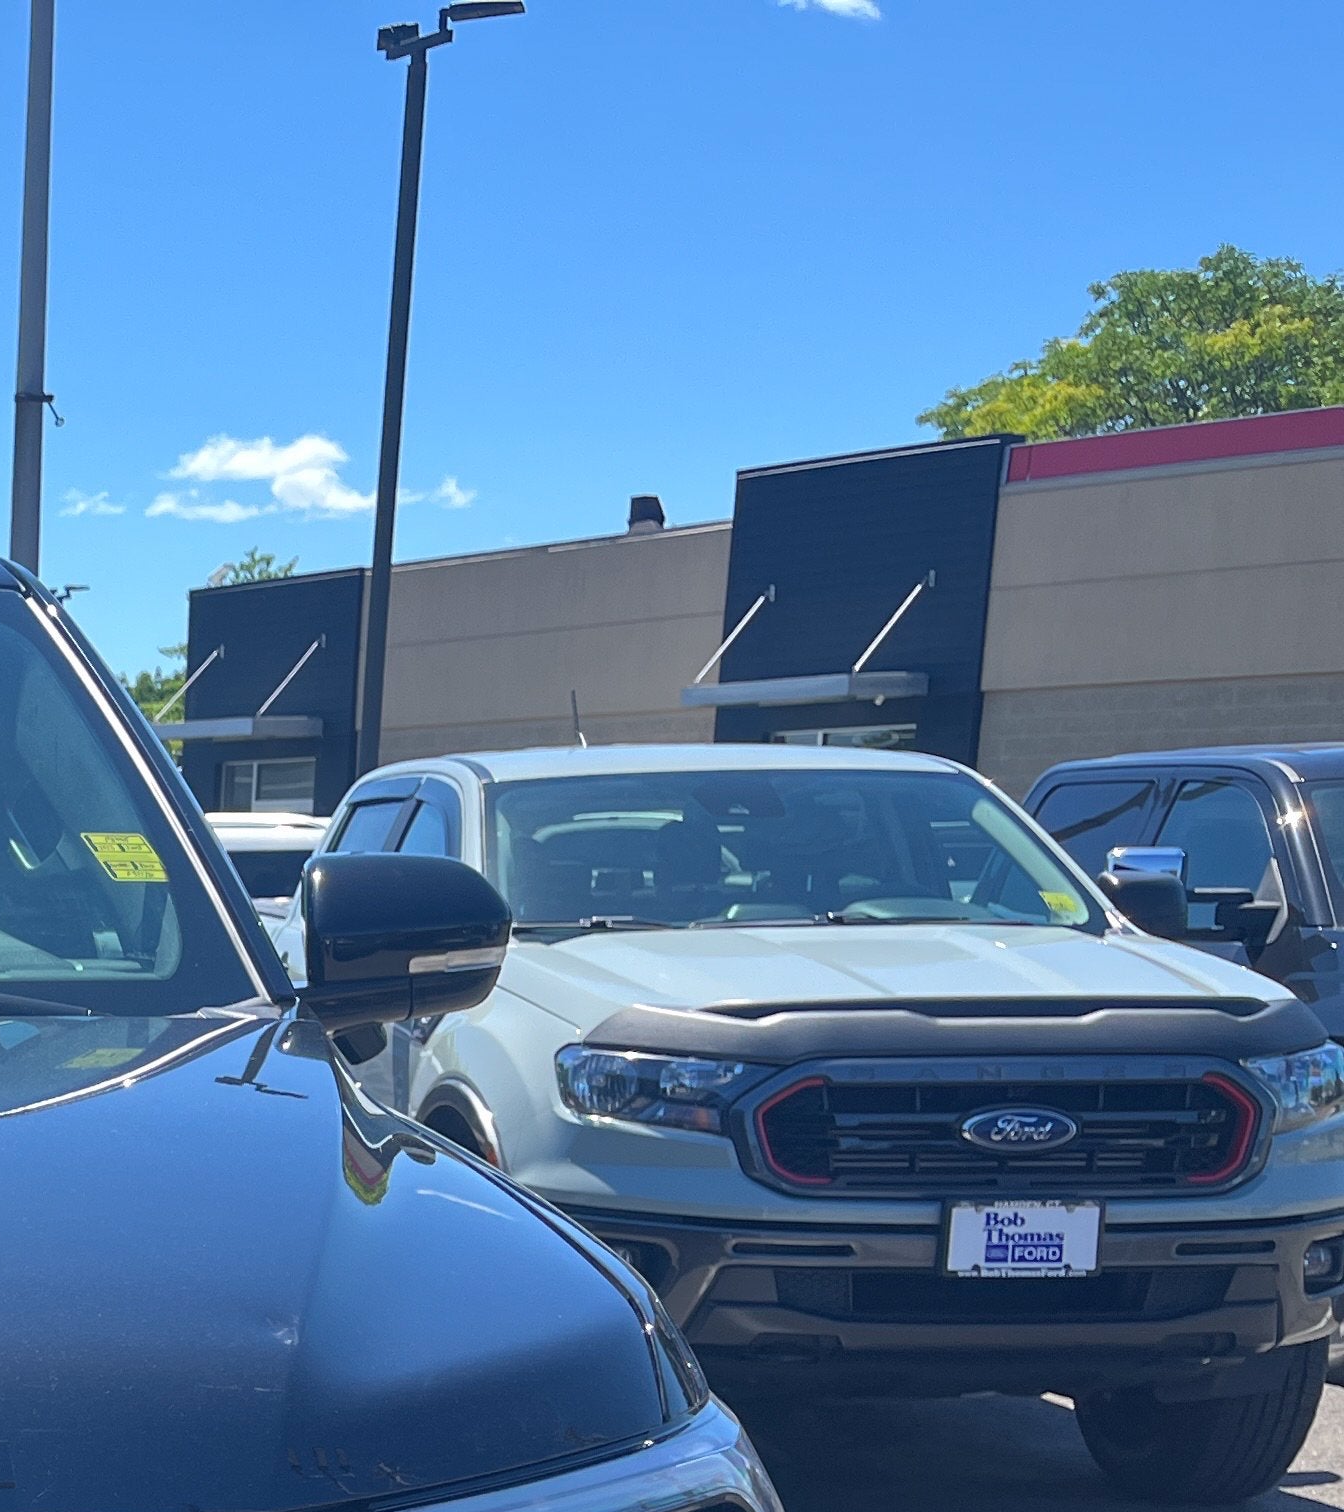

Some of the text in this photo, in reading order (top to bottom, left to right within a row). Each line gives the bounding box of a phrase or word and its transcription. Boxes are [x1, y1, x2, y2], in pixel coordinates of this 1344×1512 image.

[989, 1114, 1054, 1142] Ford
[985, 1212, 1026, 1227] Bob
[983, 1228, 1065, 1243] Thomas
[1014, 1246, 1061, 1261] FORD
